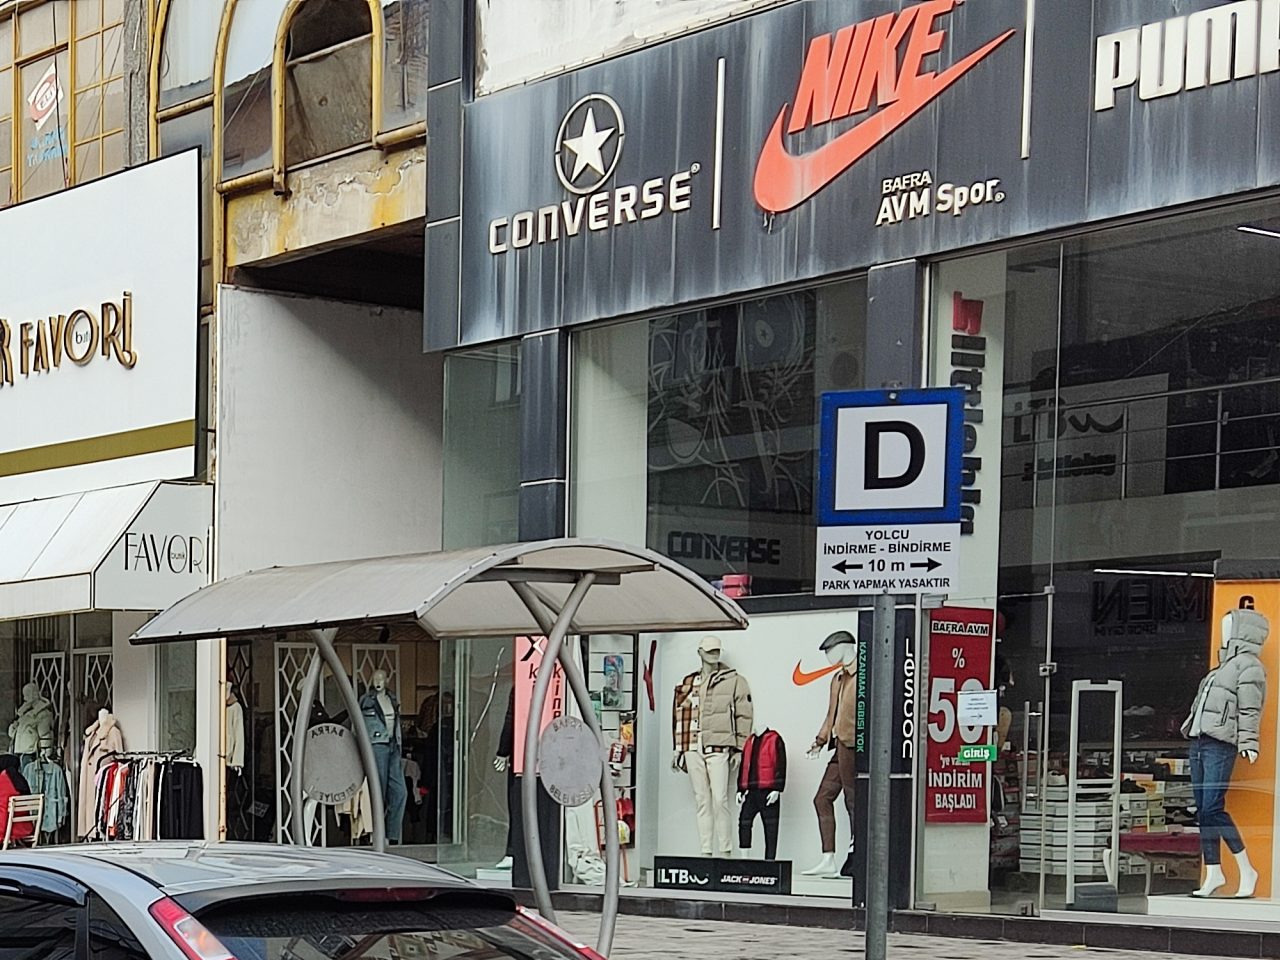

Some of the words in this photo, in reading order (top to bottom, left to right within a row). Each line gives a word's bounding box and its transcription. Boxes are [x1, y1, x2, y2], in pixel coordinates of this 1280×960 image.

[787, 0, 955, 135] NIKE
[882, 170, 933, 195] BAFRA
[489, 170, 692, 255] CONVERSE
[875, 188, 931, 227] AVM
[864, 421, 926, 490] D
[865, 529, 910, 541] YOLCU
[824, 542, 877, 555] İNDİRME
[888, 540, 952, 553] BİNDİRME
[869, 559, 886, 572] 10
[891, 562, 905, 572] m
[822, 579, 851, 590] PARK
[852, 578, 896, 590] YAPMAK
[899, 577, 950, 588] YASAKTIR
[932, 622, 966, 633] BAFRA
[967, 625, 989, 635] AVM
[951, 647, 965, 668] %
[856, 731, 865, 752] YOK
[928, 769, 983, 788] İNDİRİM
[935, 794, 976, 813] BAŞLADI
[660, 869, 689, 884] LTB
